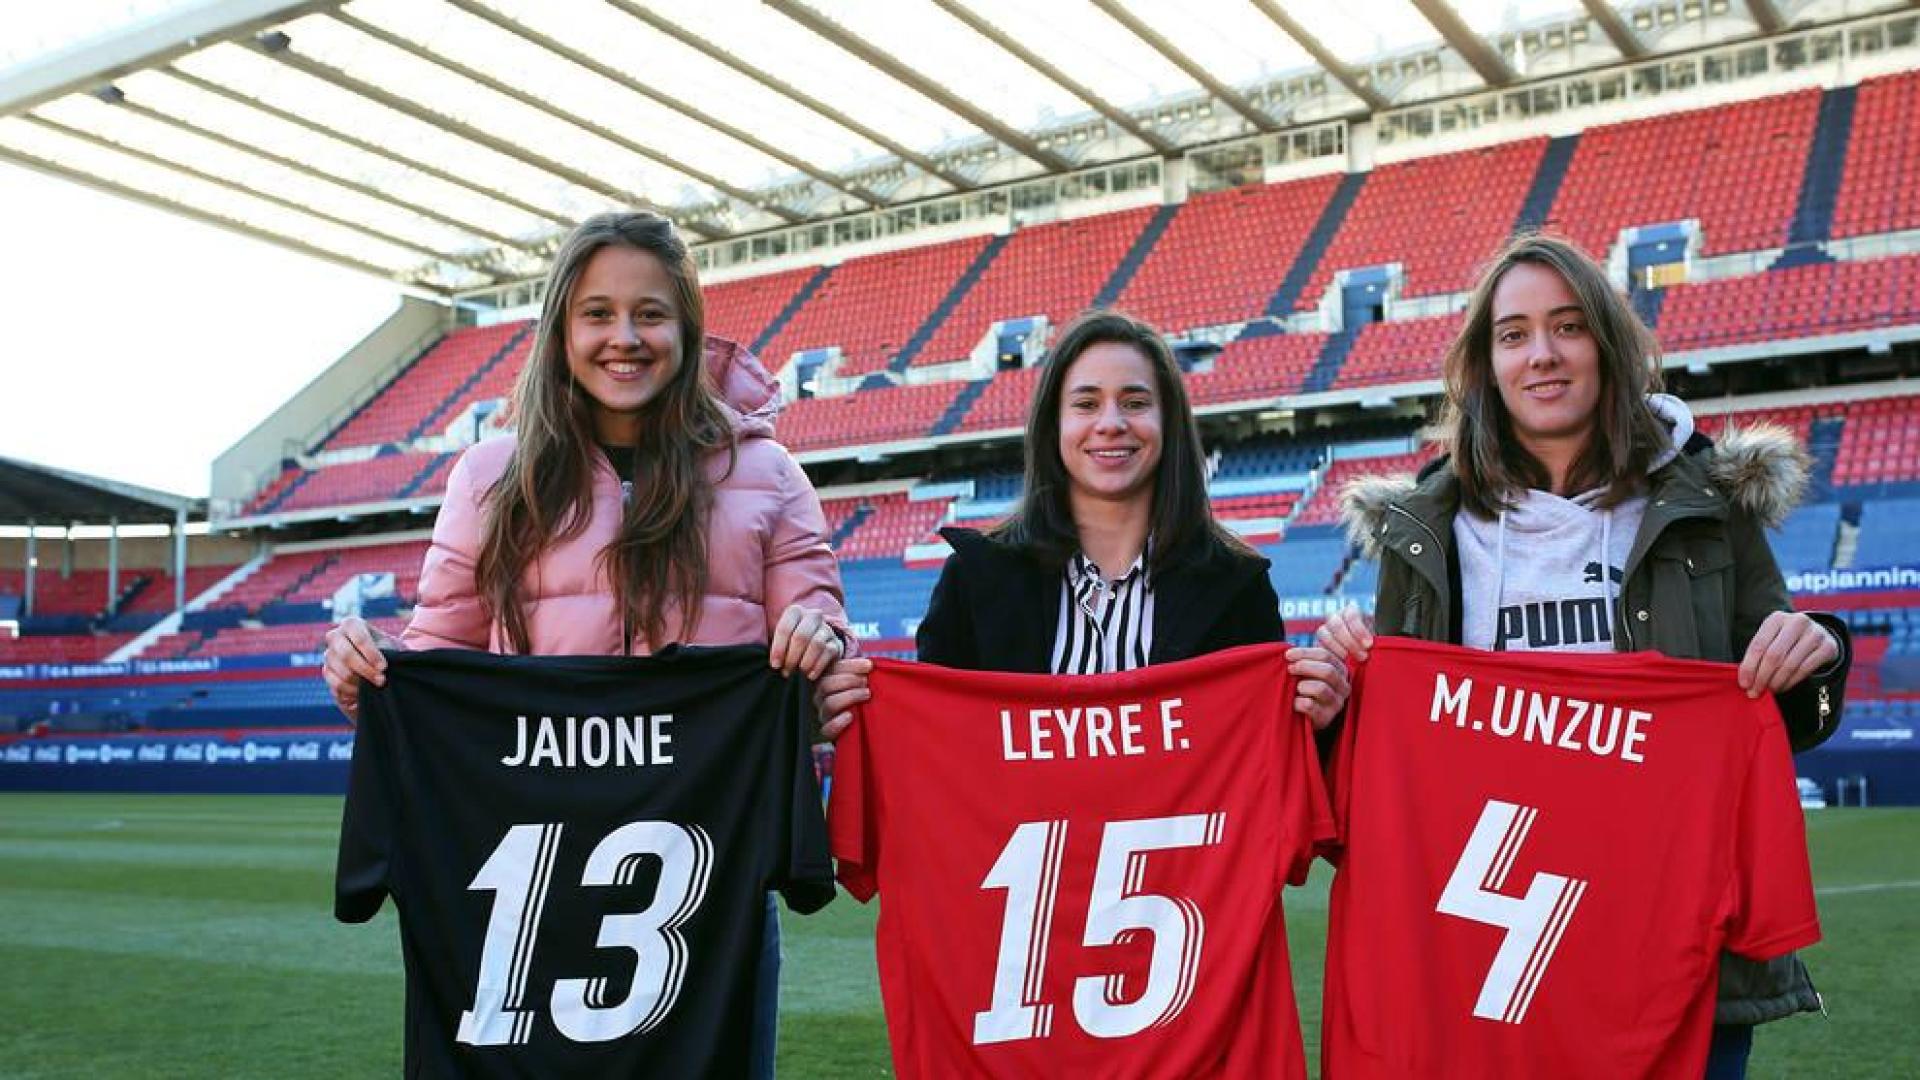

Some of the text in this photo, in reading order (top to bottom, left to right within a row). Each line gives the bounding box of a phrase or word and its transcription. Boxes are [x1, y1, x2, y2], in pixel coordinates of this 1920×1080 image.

[1786, 567, 1920, 592] etplannin
[1498, 597, 1620, 650] PUM
[500, 714, 674, 767] JAIONE
[1000, 698, 1190, 761] LEYRE F.
[1429, 672, 1652, 763] M.UNZUE
[455, 820, 715, 1046] 13
[972, 812, 1227, 1046] 15
[1435, 799, 1588, 1025] 4
